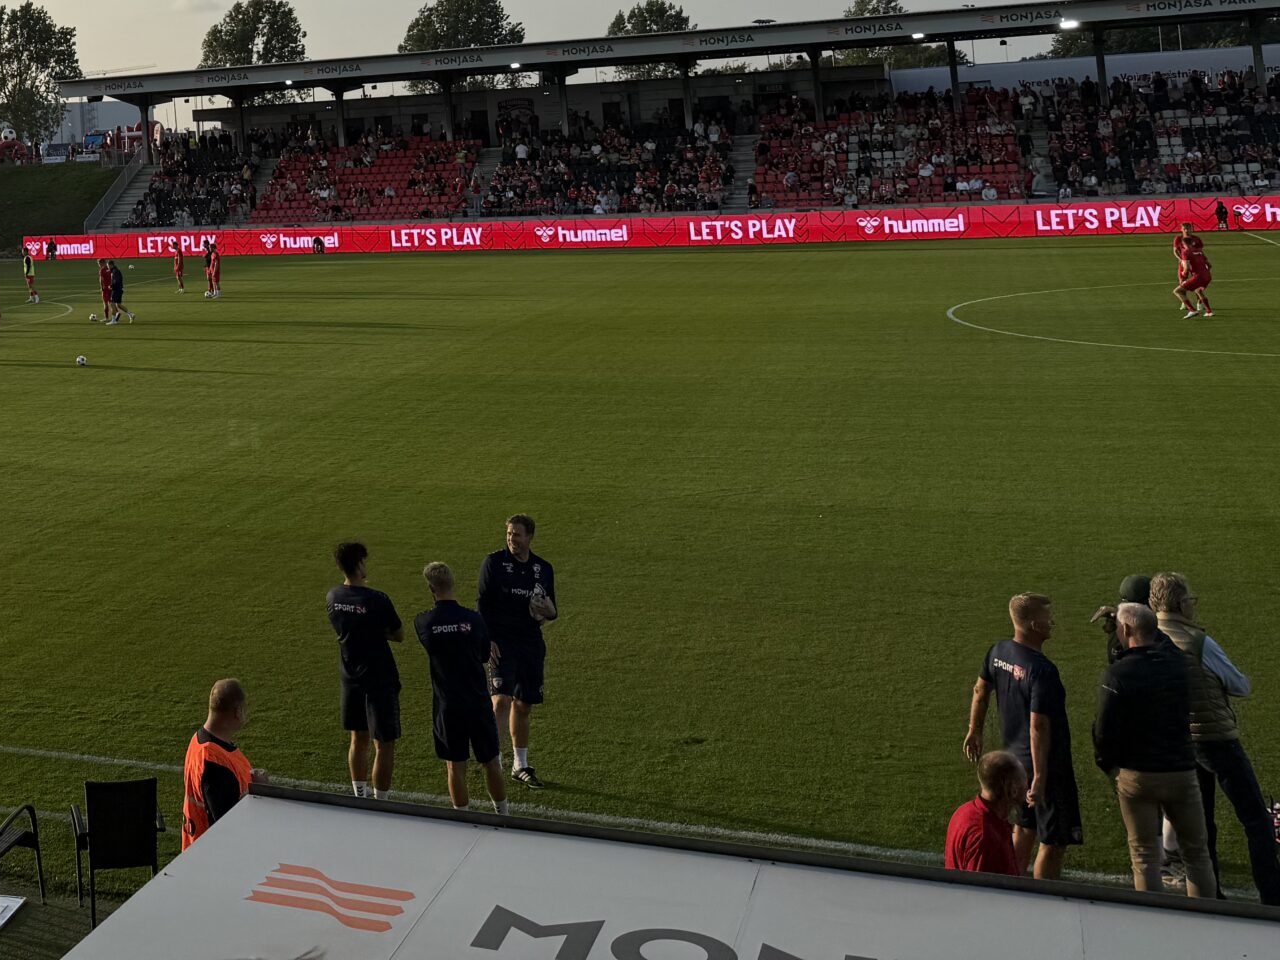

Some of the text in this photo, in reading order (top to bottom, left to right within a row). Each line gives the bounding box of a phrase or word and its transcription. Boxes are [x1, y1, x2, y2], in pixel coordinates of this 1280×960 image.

[999, 9, 1063, 24] MONJASA
[844, 22, 903, 36] MONJASA
[699, 33, 755, 47] MONJASA
[561, 44, 614, 58] MONJASA
[434, 54, 483, 67] MONJASA
[316, 64, 362, 76] MONJASA
[207, 72, 249, 85] MONJASA
[104, 81, 144, 92] MONJASA
[883, 214, 964, 234] hummel
[1036, 205, 1163, 231] LET'S PLAY
[557, 224, 628, 242] hummel
[689, 218, 797, 241] LET'S PLAY
[390, 227, 483, 248] LET'S PLAY
[333, 603, 355, 613] SPORT
[432, 624, 458, 634] SPORT
